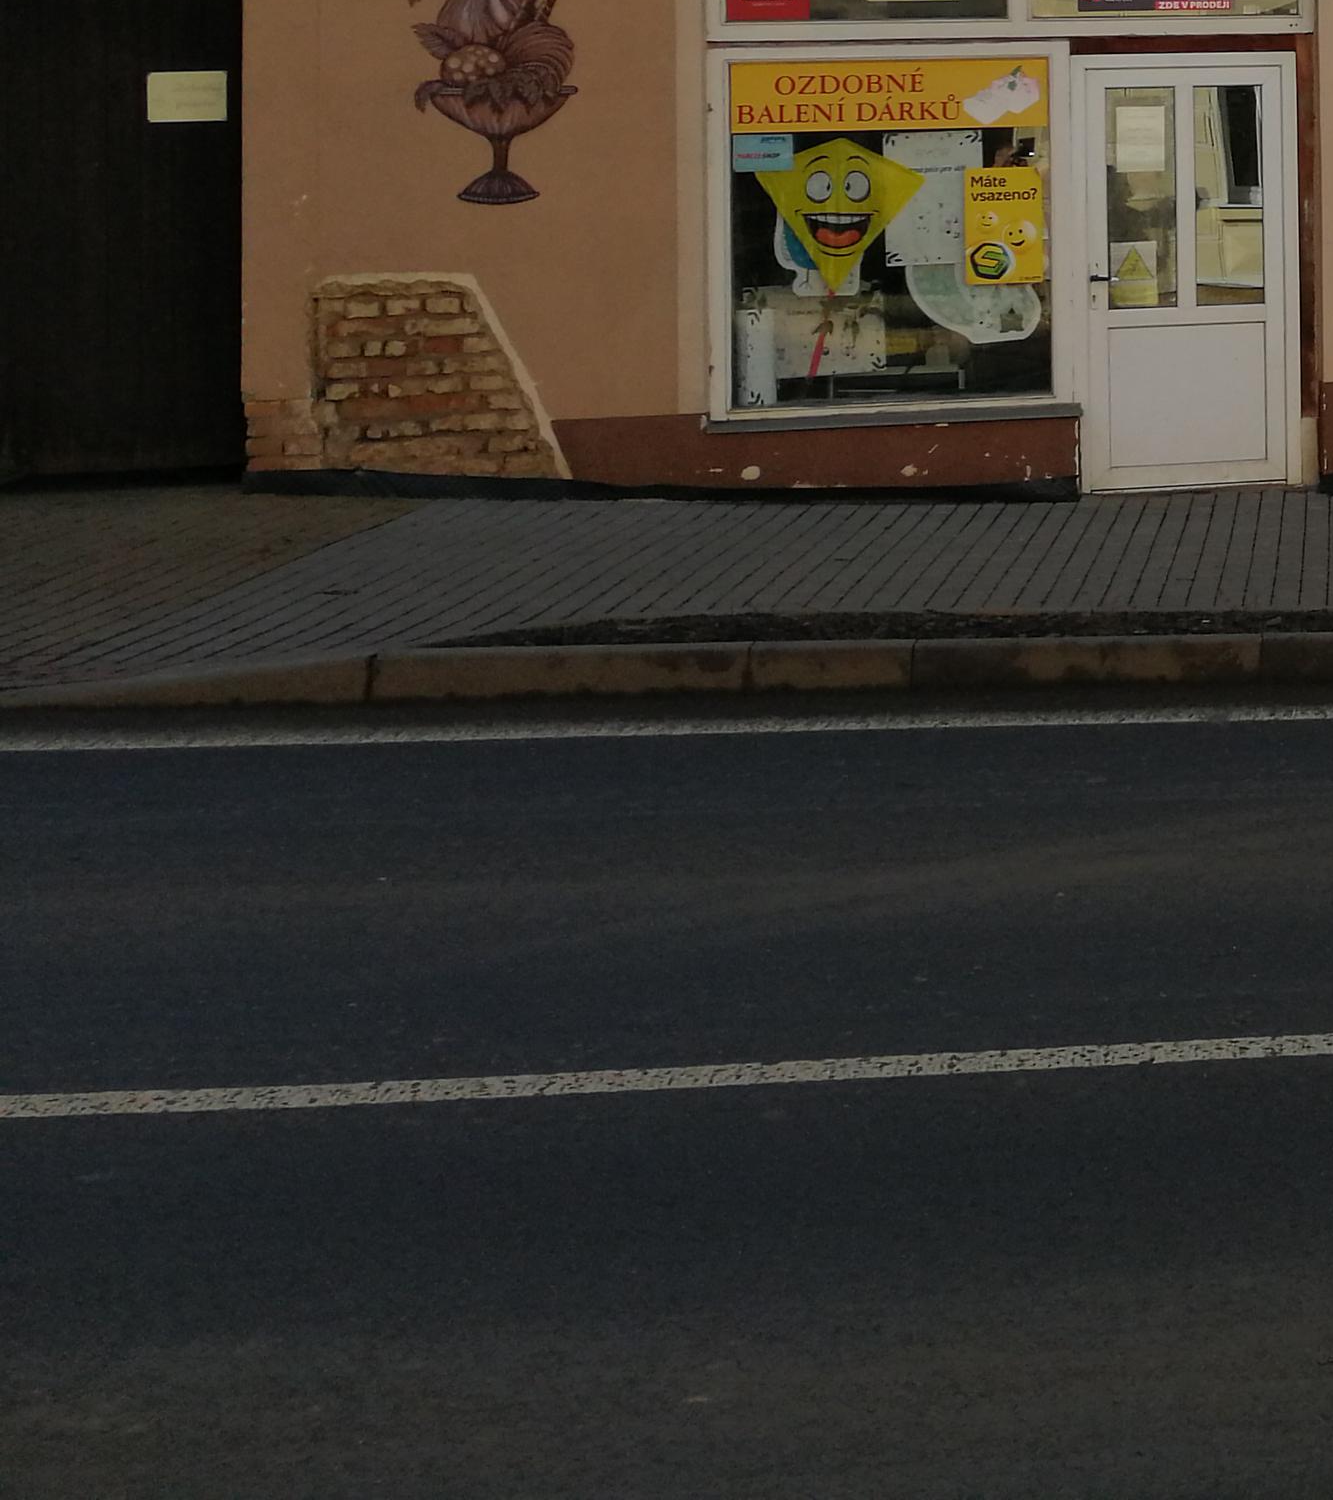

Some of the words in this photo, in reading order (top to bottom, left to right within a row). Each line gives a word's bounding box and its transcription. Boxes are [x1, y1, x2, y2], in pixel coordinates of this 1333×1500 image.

[1158, 0, 1180, 10] ZDE
[1182, 0, 1191, 10] V
[1191, 0, 1231, 10] PRODEJI
[773, 67, 925, 96] OZDOBNÉ
[736, 97, 846, 126] BALENÍ
[856, 94, 962, 123] DÁRKŮ
[970, 174, 1007, 188] Máte
[970, 187, 1038, 203] vsazeno?
